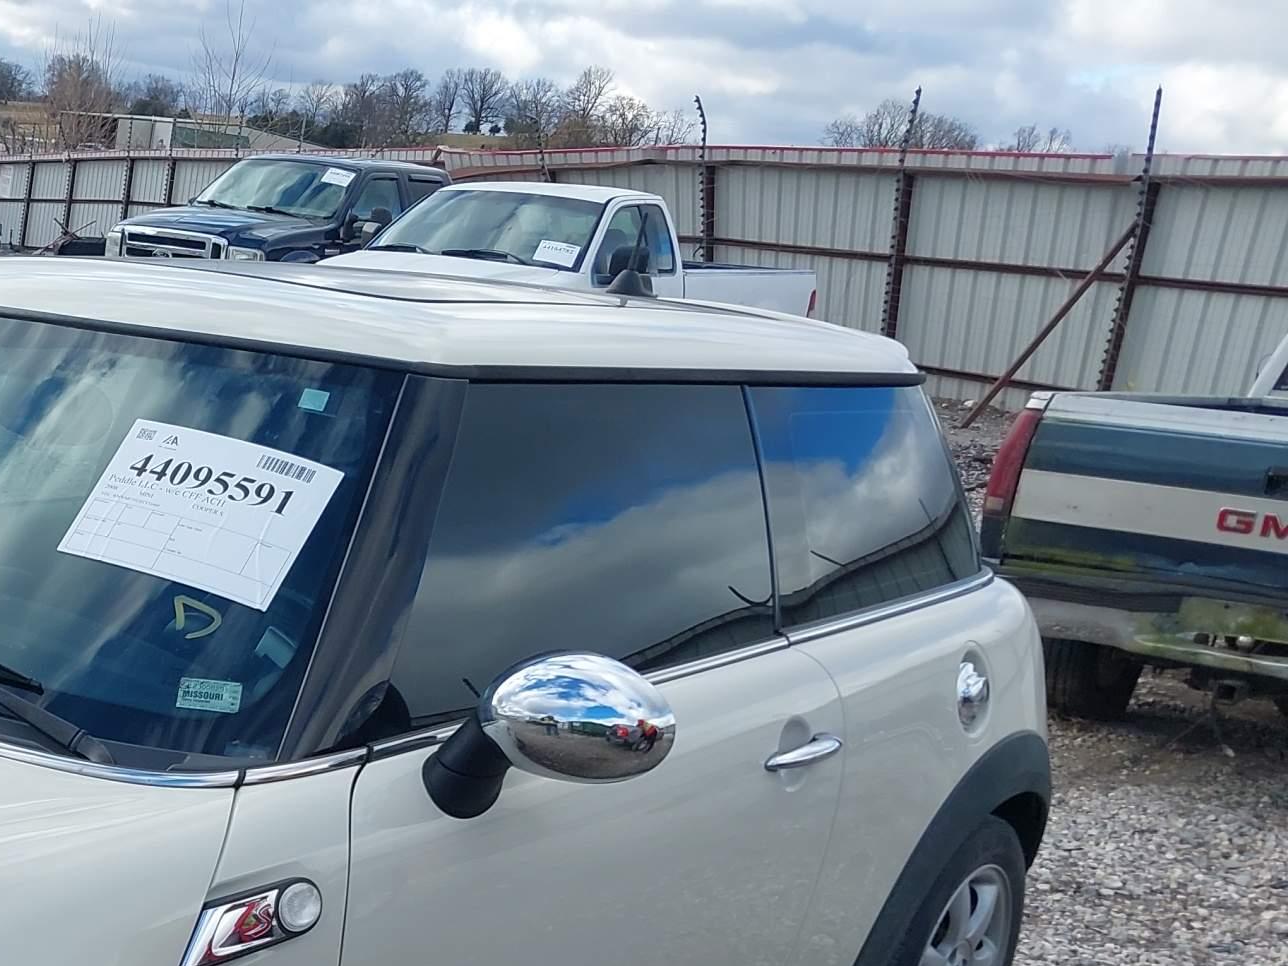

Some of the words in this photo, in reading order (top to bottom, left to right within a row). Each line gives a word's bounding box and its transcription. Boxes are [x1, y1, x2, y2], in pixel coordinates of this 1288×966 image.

[109, 474, 137, 487] Peddle
[138, 479, 159, 491] LLC
[128, 454, 296, 518] 44095591
[182, 690, 224, 702] MISSOURI
